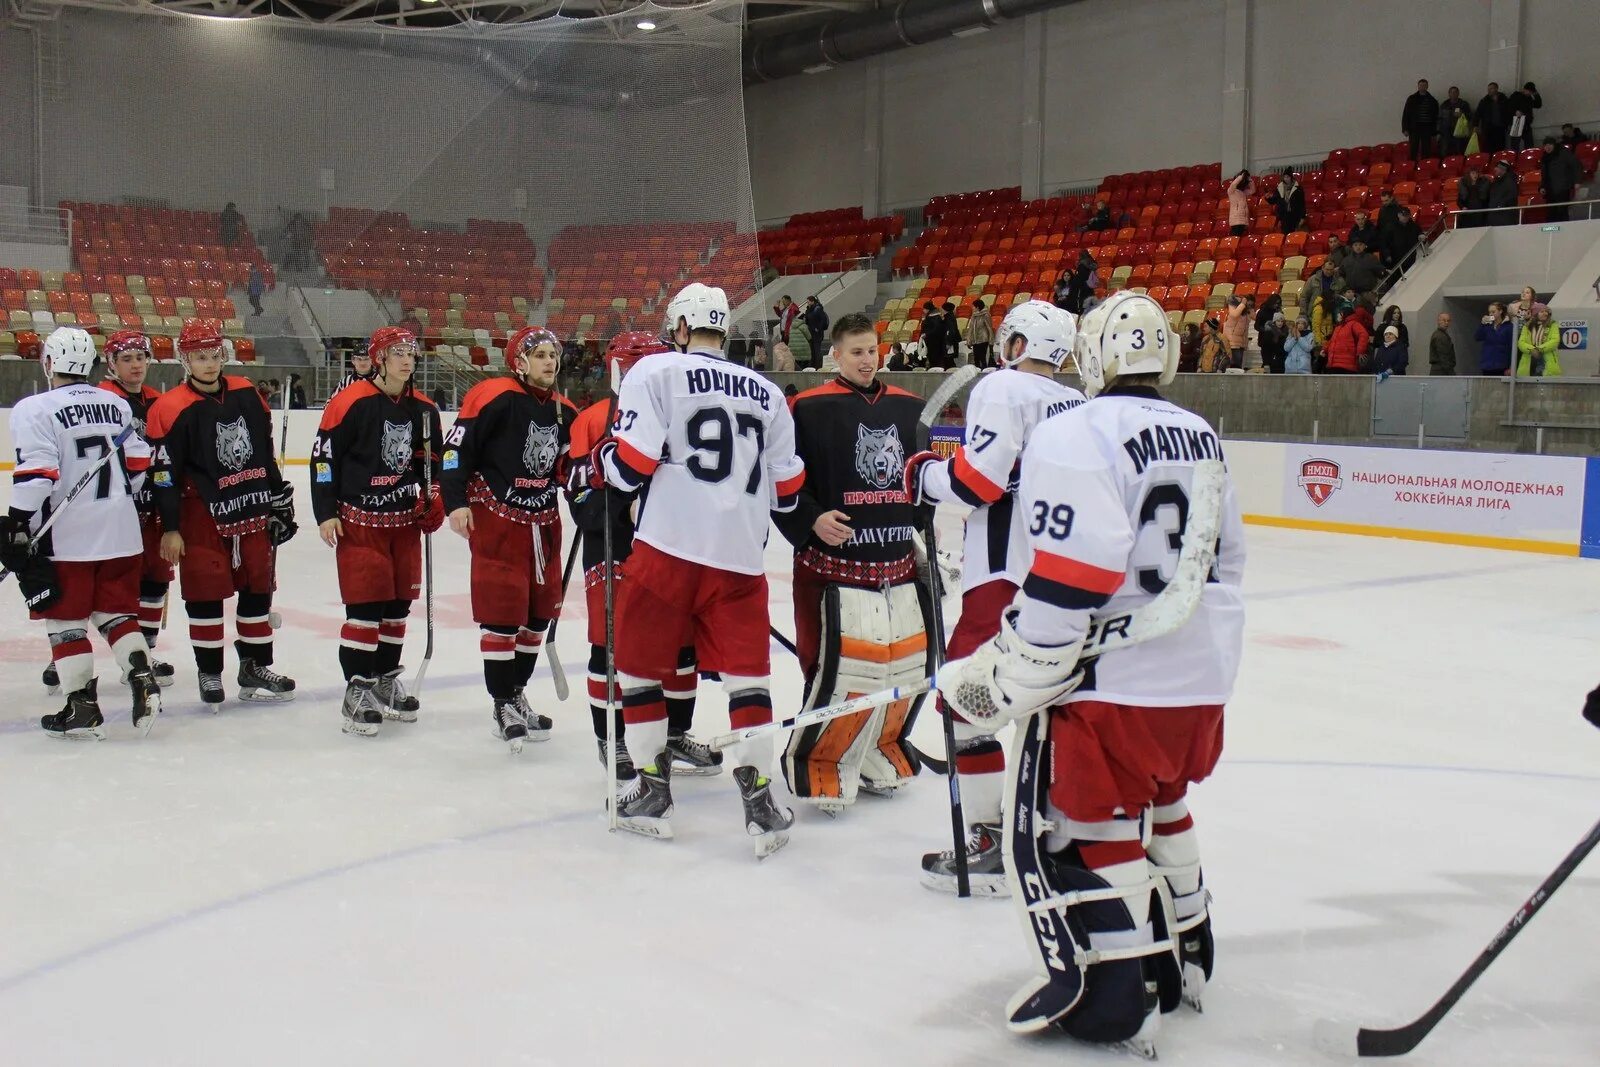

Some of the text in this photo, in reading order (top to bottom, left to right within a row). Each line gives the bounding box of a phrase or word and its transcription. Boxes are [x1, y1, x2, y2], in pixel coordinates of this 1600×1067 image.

[709, 309, 726, 327] 97
[1565, 331, 1579, 345] 10
[1048, 347, 1069, 364] 47
[68, 361, 87, 373] 71
[313, 436, 333, 458] 34
[685, 405, 766, 496] 97
[1123, 424, 1228, 475] МАЛКО
[1307, 465, 1333, 477] НМХЛ
[1352, 472, 1564, 496] НАЦИОНАЛЬНАЯ МОЛОДЕЖНАЯ
[1394, 491, 1511, 510] ХОККЕЙНАЯ ЛИГА
[1029, 500, 1075, 541] 39
[1020, 654, 1060, 666] CCM
[1024, 872, 1066, 972] CCM
